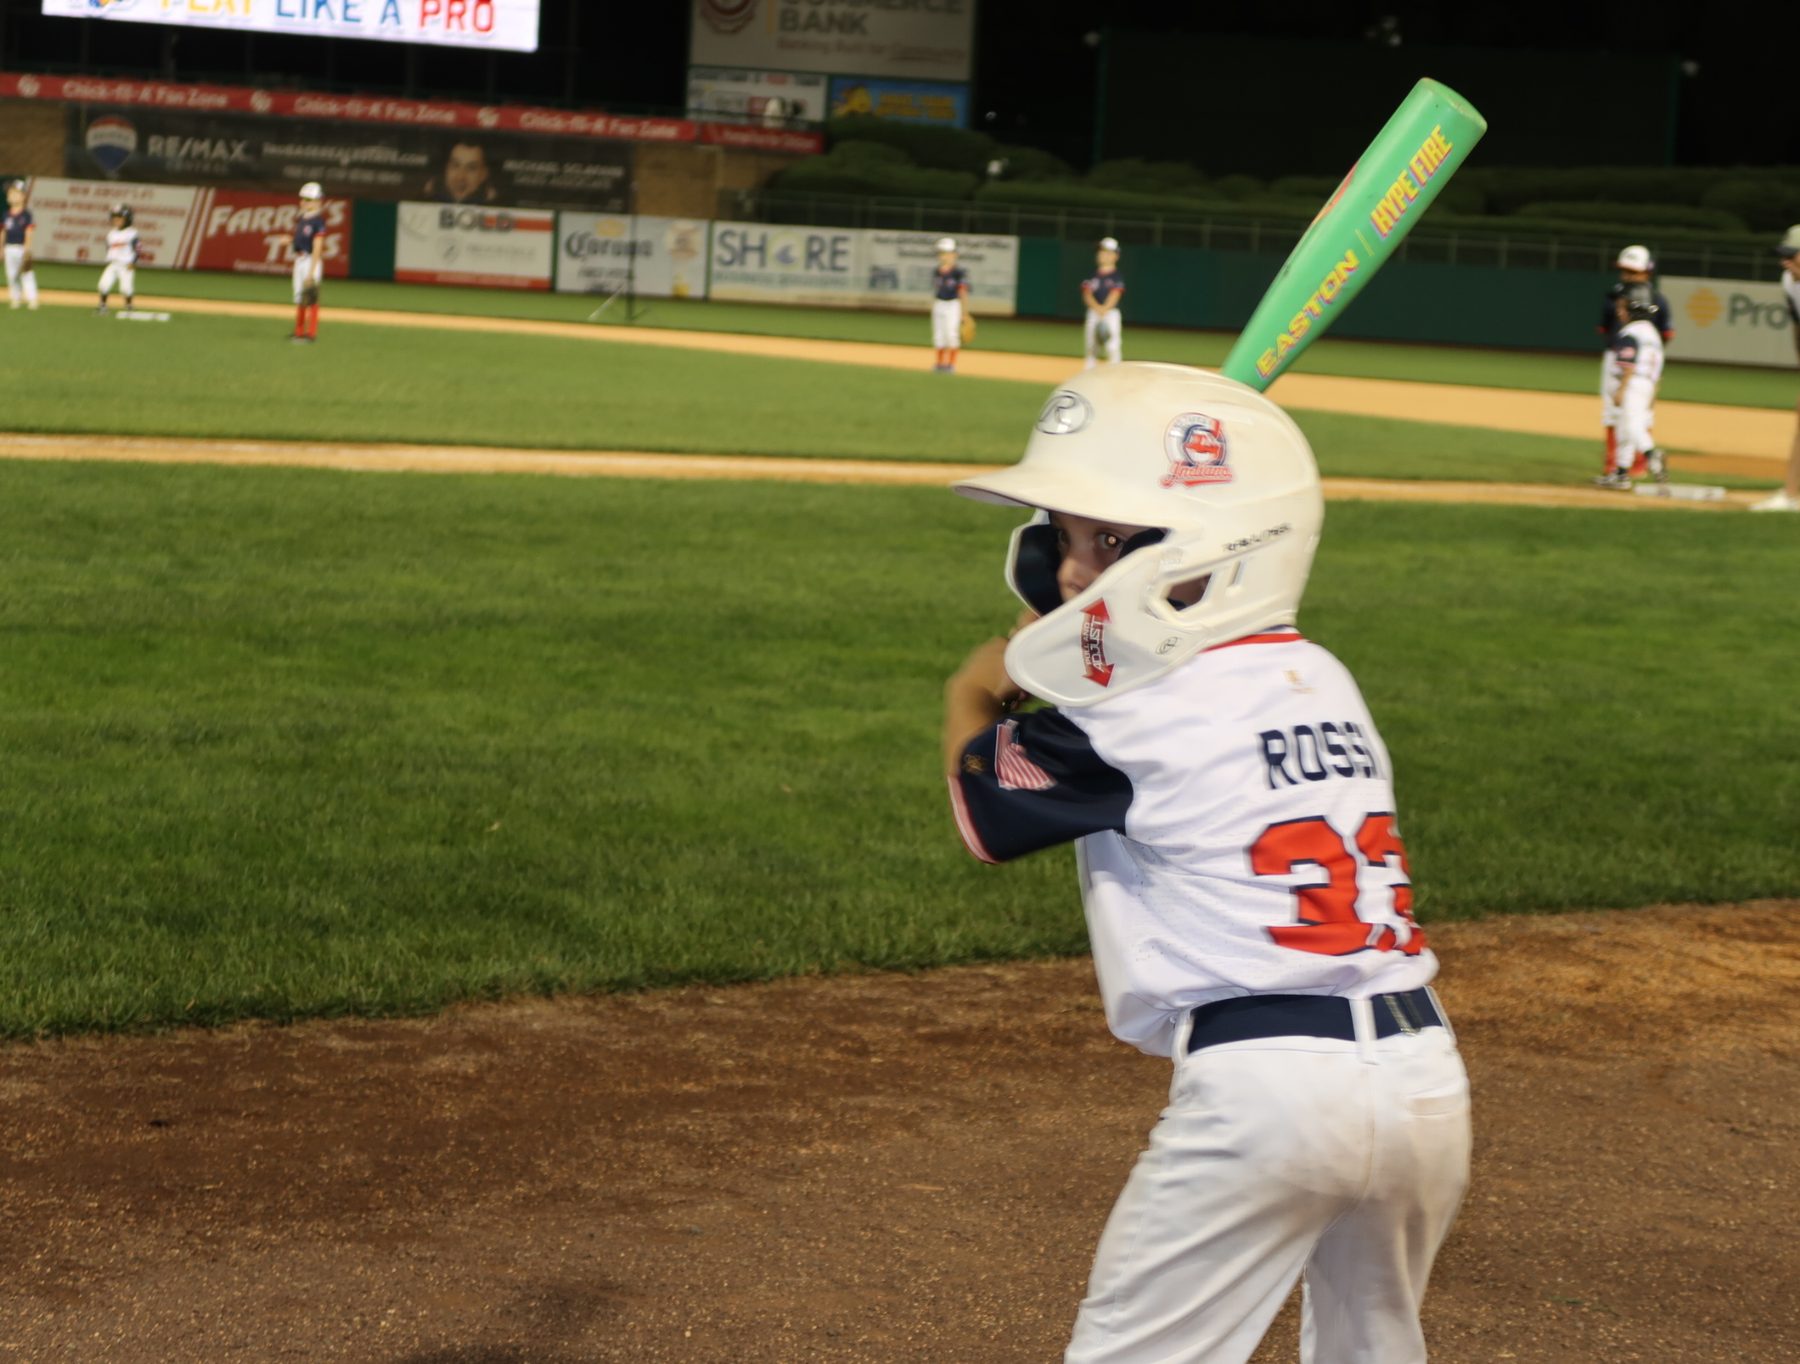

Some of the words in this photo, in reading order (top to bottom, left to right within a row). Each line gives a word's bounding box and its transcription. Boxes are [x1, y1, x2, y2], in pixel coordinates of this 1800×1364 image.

[419, 0, 494, 33] PRO
[780, 9, 869, 35] BANK
[147, 135, 247, 162] RE/MAX
[1256, 249, 1359, 379] EASTON
[1370, 170, 1420, 239] HYPE
[1409, 124, 1453, 187] FIRE
[1089, 614, 1105, 673] ADJUST
